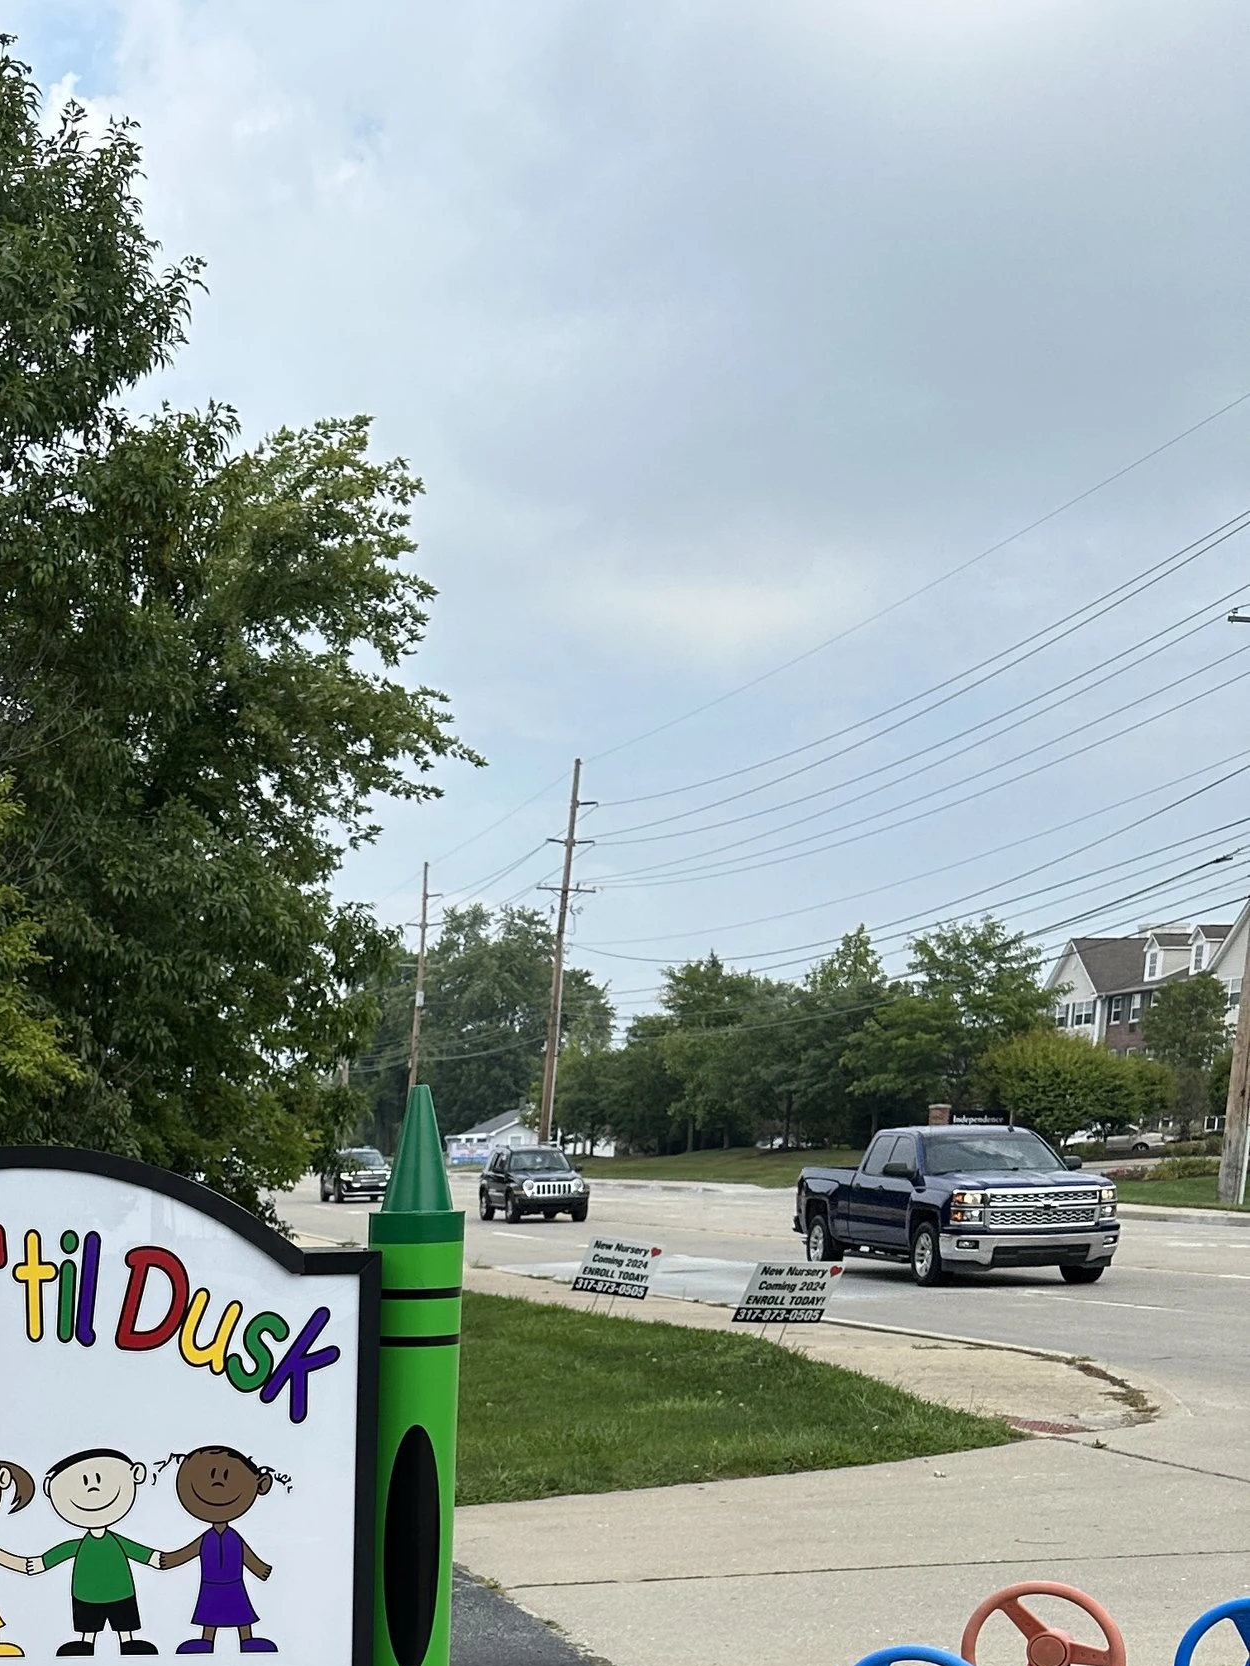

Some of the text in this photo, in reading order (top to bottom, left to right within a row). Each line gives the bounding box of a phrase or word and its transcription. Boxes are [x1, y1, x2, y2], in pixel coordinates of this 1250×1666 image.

[593, 1240, 650, 1257] New Nursery
[592, 1253, 649, 1269] Coming 2024
[582, 1266, 650, 1284] ENROLL TODAY!
[760, 1265, 828, 1279] New Nursery
[575, 1278, 645, 1298] 317-873-0505
[758, 1280, 827, 1293] Coming 2024
[745, 1295, 827, 1306] ENROLL TODAY!
[736, 1308, 821, 1321] 317-873-0505
[115, 1245, 341, 1423] Dusk
